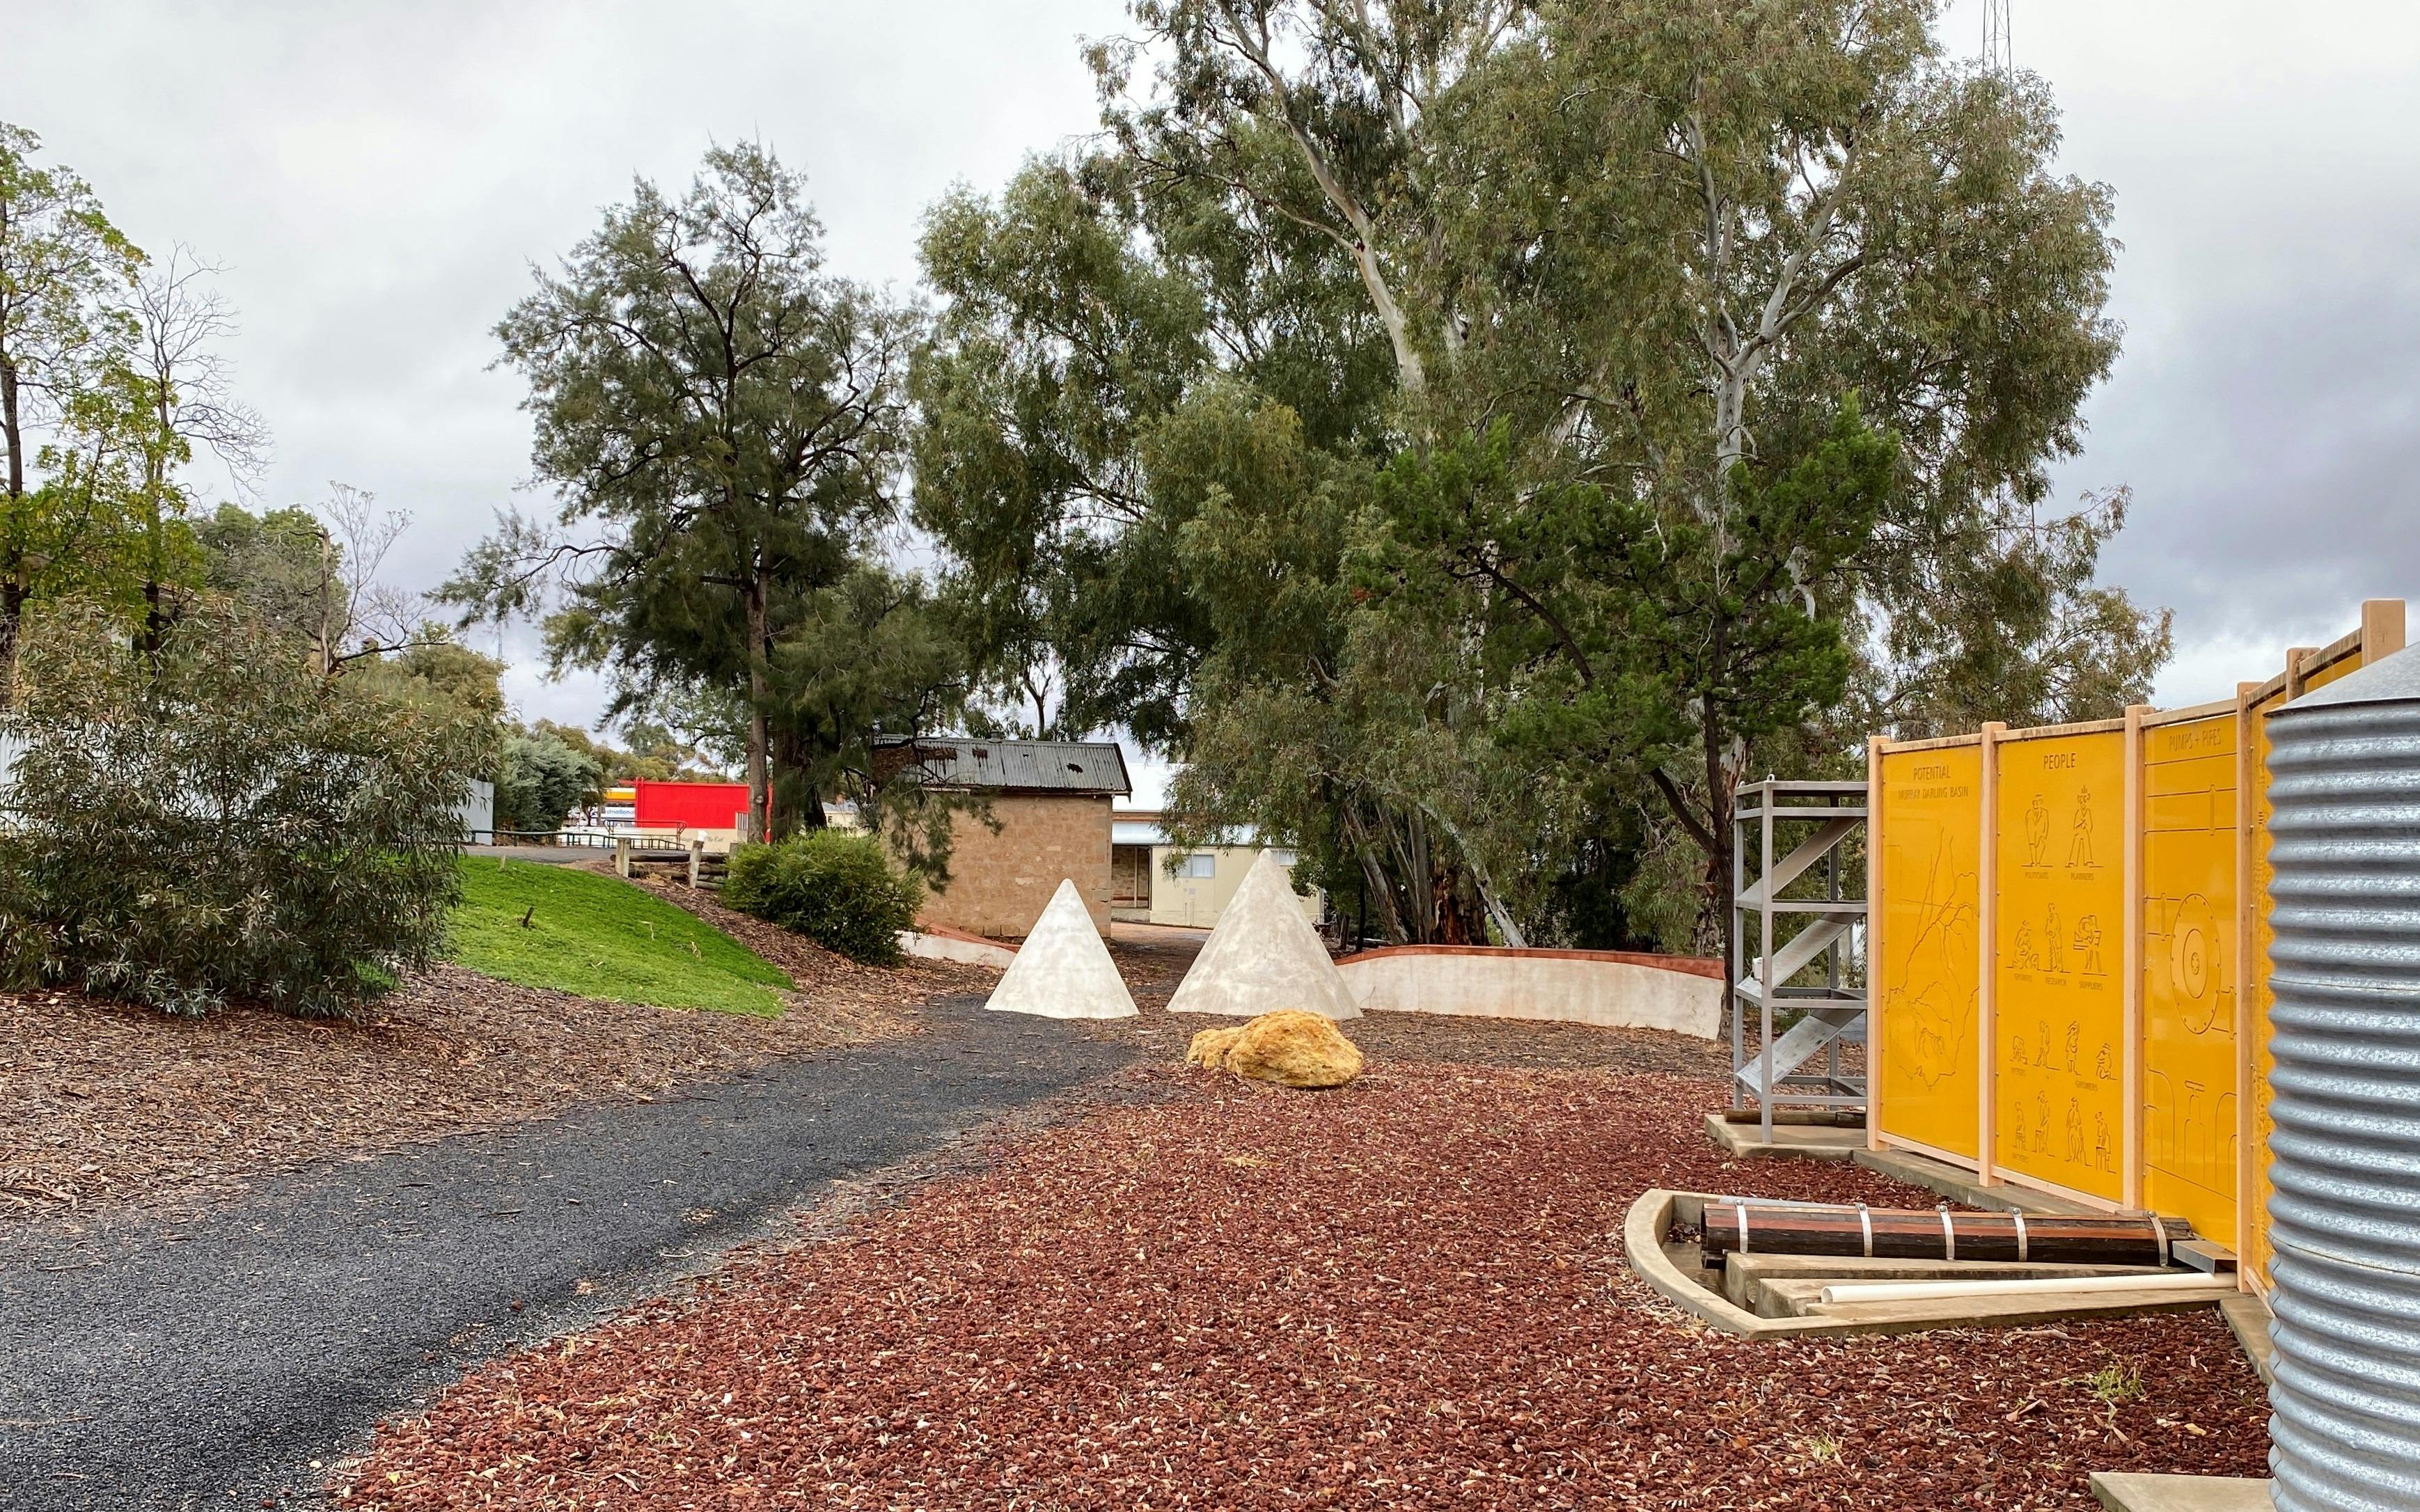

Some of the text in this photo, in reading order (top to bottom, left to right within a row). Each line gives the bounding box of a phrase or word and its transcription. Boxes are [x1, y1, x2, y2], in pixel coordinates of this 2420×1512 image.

[2169, 733, 2193, 752] PUMPS
[2202, 728, 2222, 747] PIPES
[2043, 753, 2076, 770] PEOPLE
[1913, 766, 1951, 780] POTENTIAL
[1922, 787, 1948, 798] DARLING
[1950, 786, 1969, 798] BASIN
